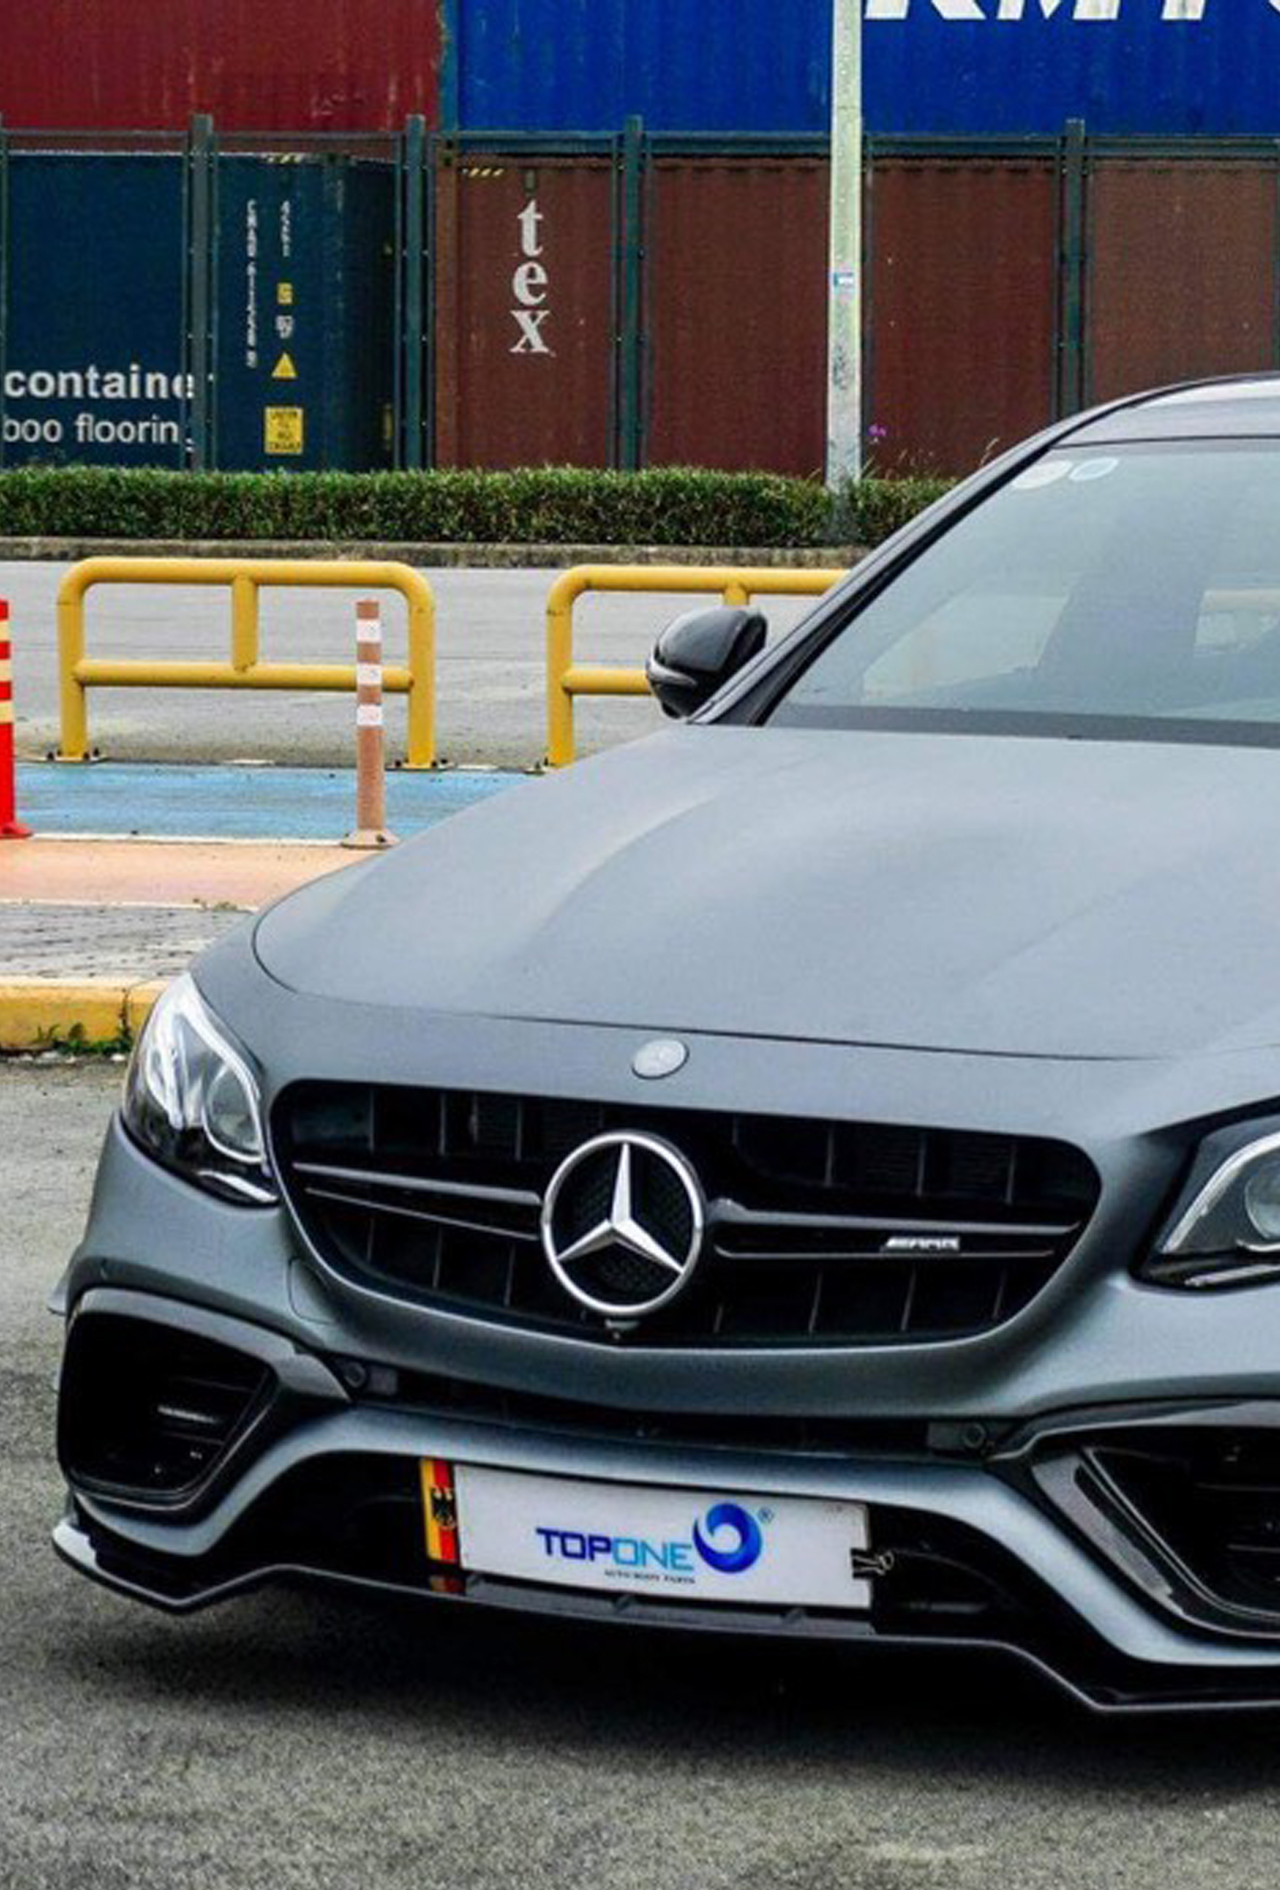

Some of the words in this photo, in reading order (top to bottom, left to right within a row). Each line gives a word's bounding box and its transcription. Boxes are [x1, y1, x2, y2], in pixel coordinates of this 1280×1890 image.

[509, 199, 551, 354] tex
[4, 364, 214, 399] containe
[75, 413, 194, 452] floorin
[536, 1527, 694, 1570] TOPONE
